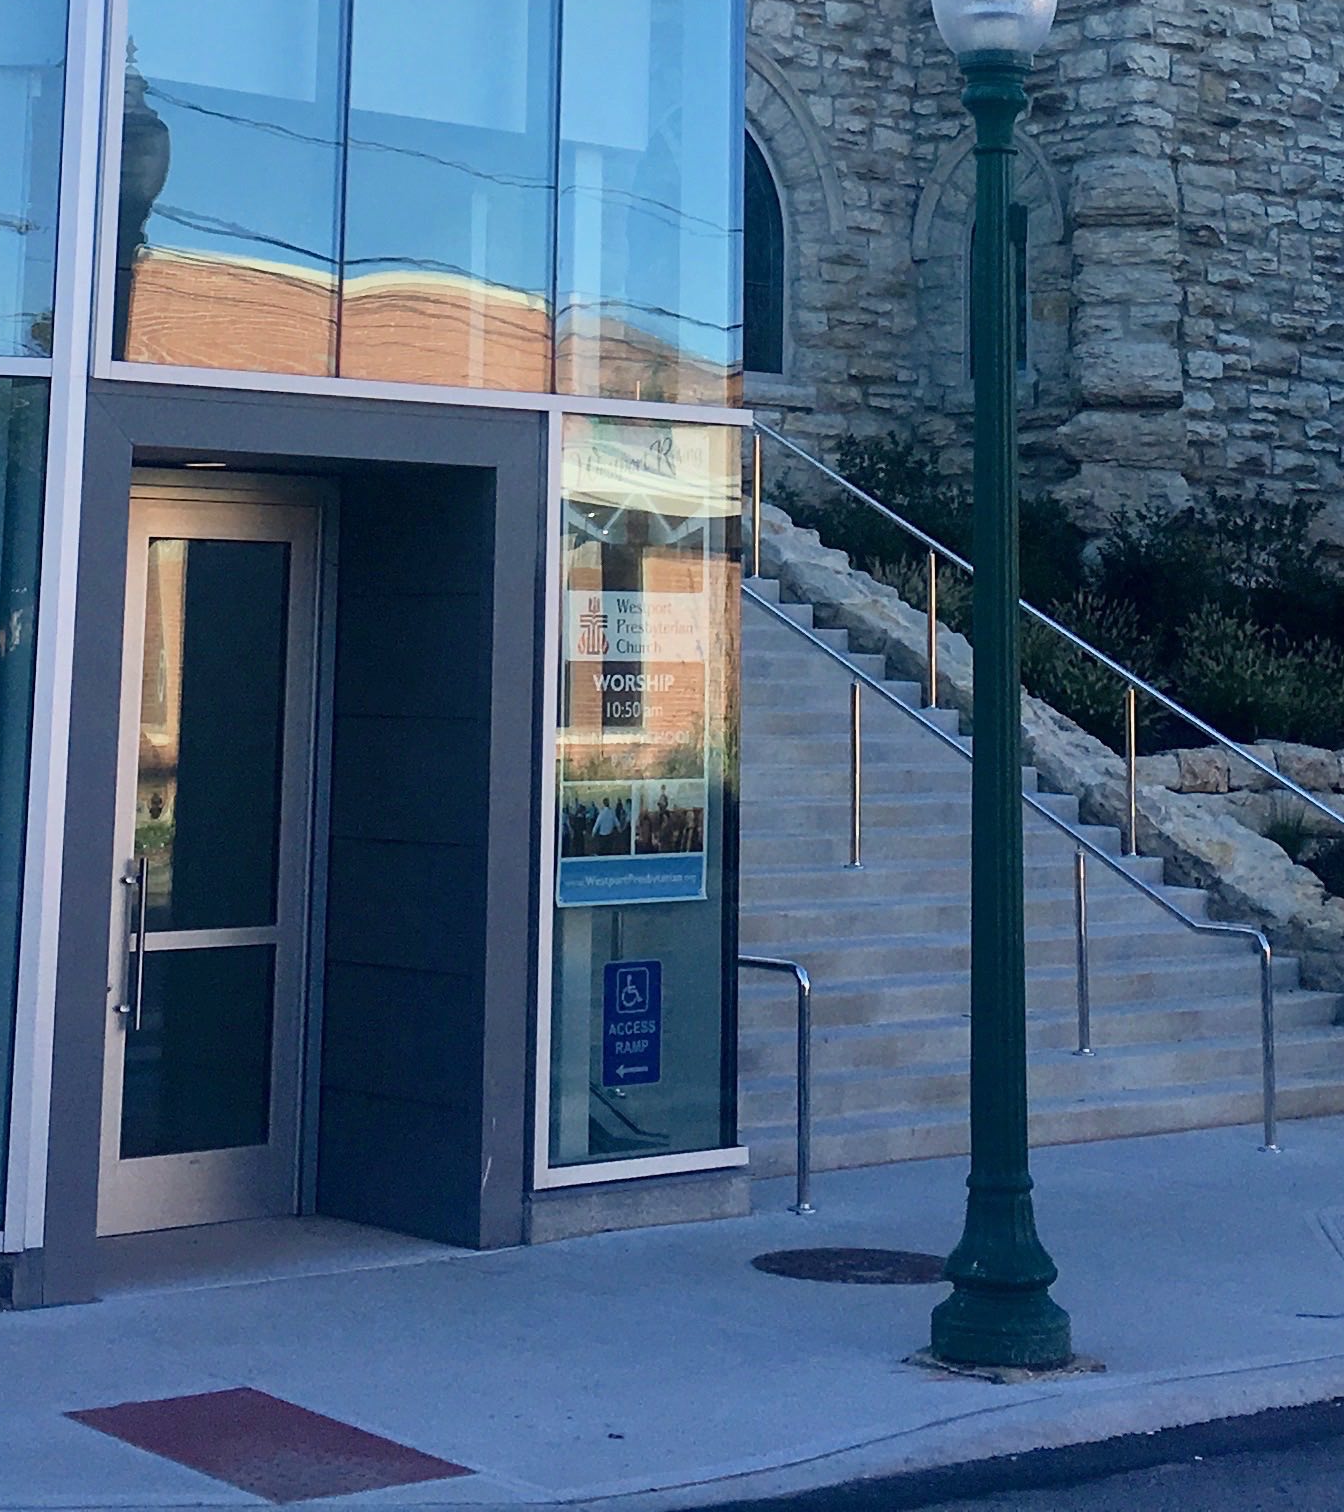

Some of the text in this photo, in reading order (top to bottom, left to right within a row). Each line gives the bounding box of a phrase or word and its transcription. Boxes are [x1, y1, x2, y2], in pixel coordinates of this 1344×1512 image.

[616, 598, 673, 615] Wesport
[616, 618, 694, 636] Presbyterian
[616, 638, 662, 655] Church
[592, 674, 676, 692] WORSHIP
[605, 701, 664, 718] 10:50 am
[608, 1020, 656, 1036] ACCESS
[615, 1039, 649, 1055] RAMP
